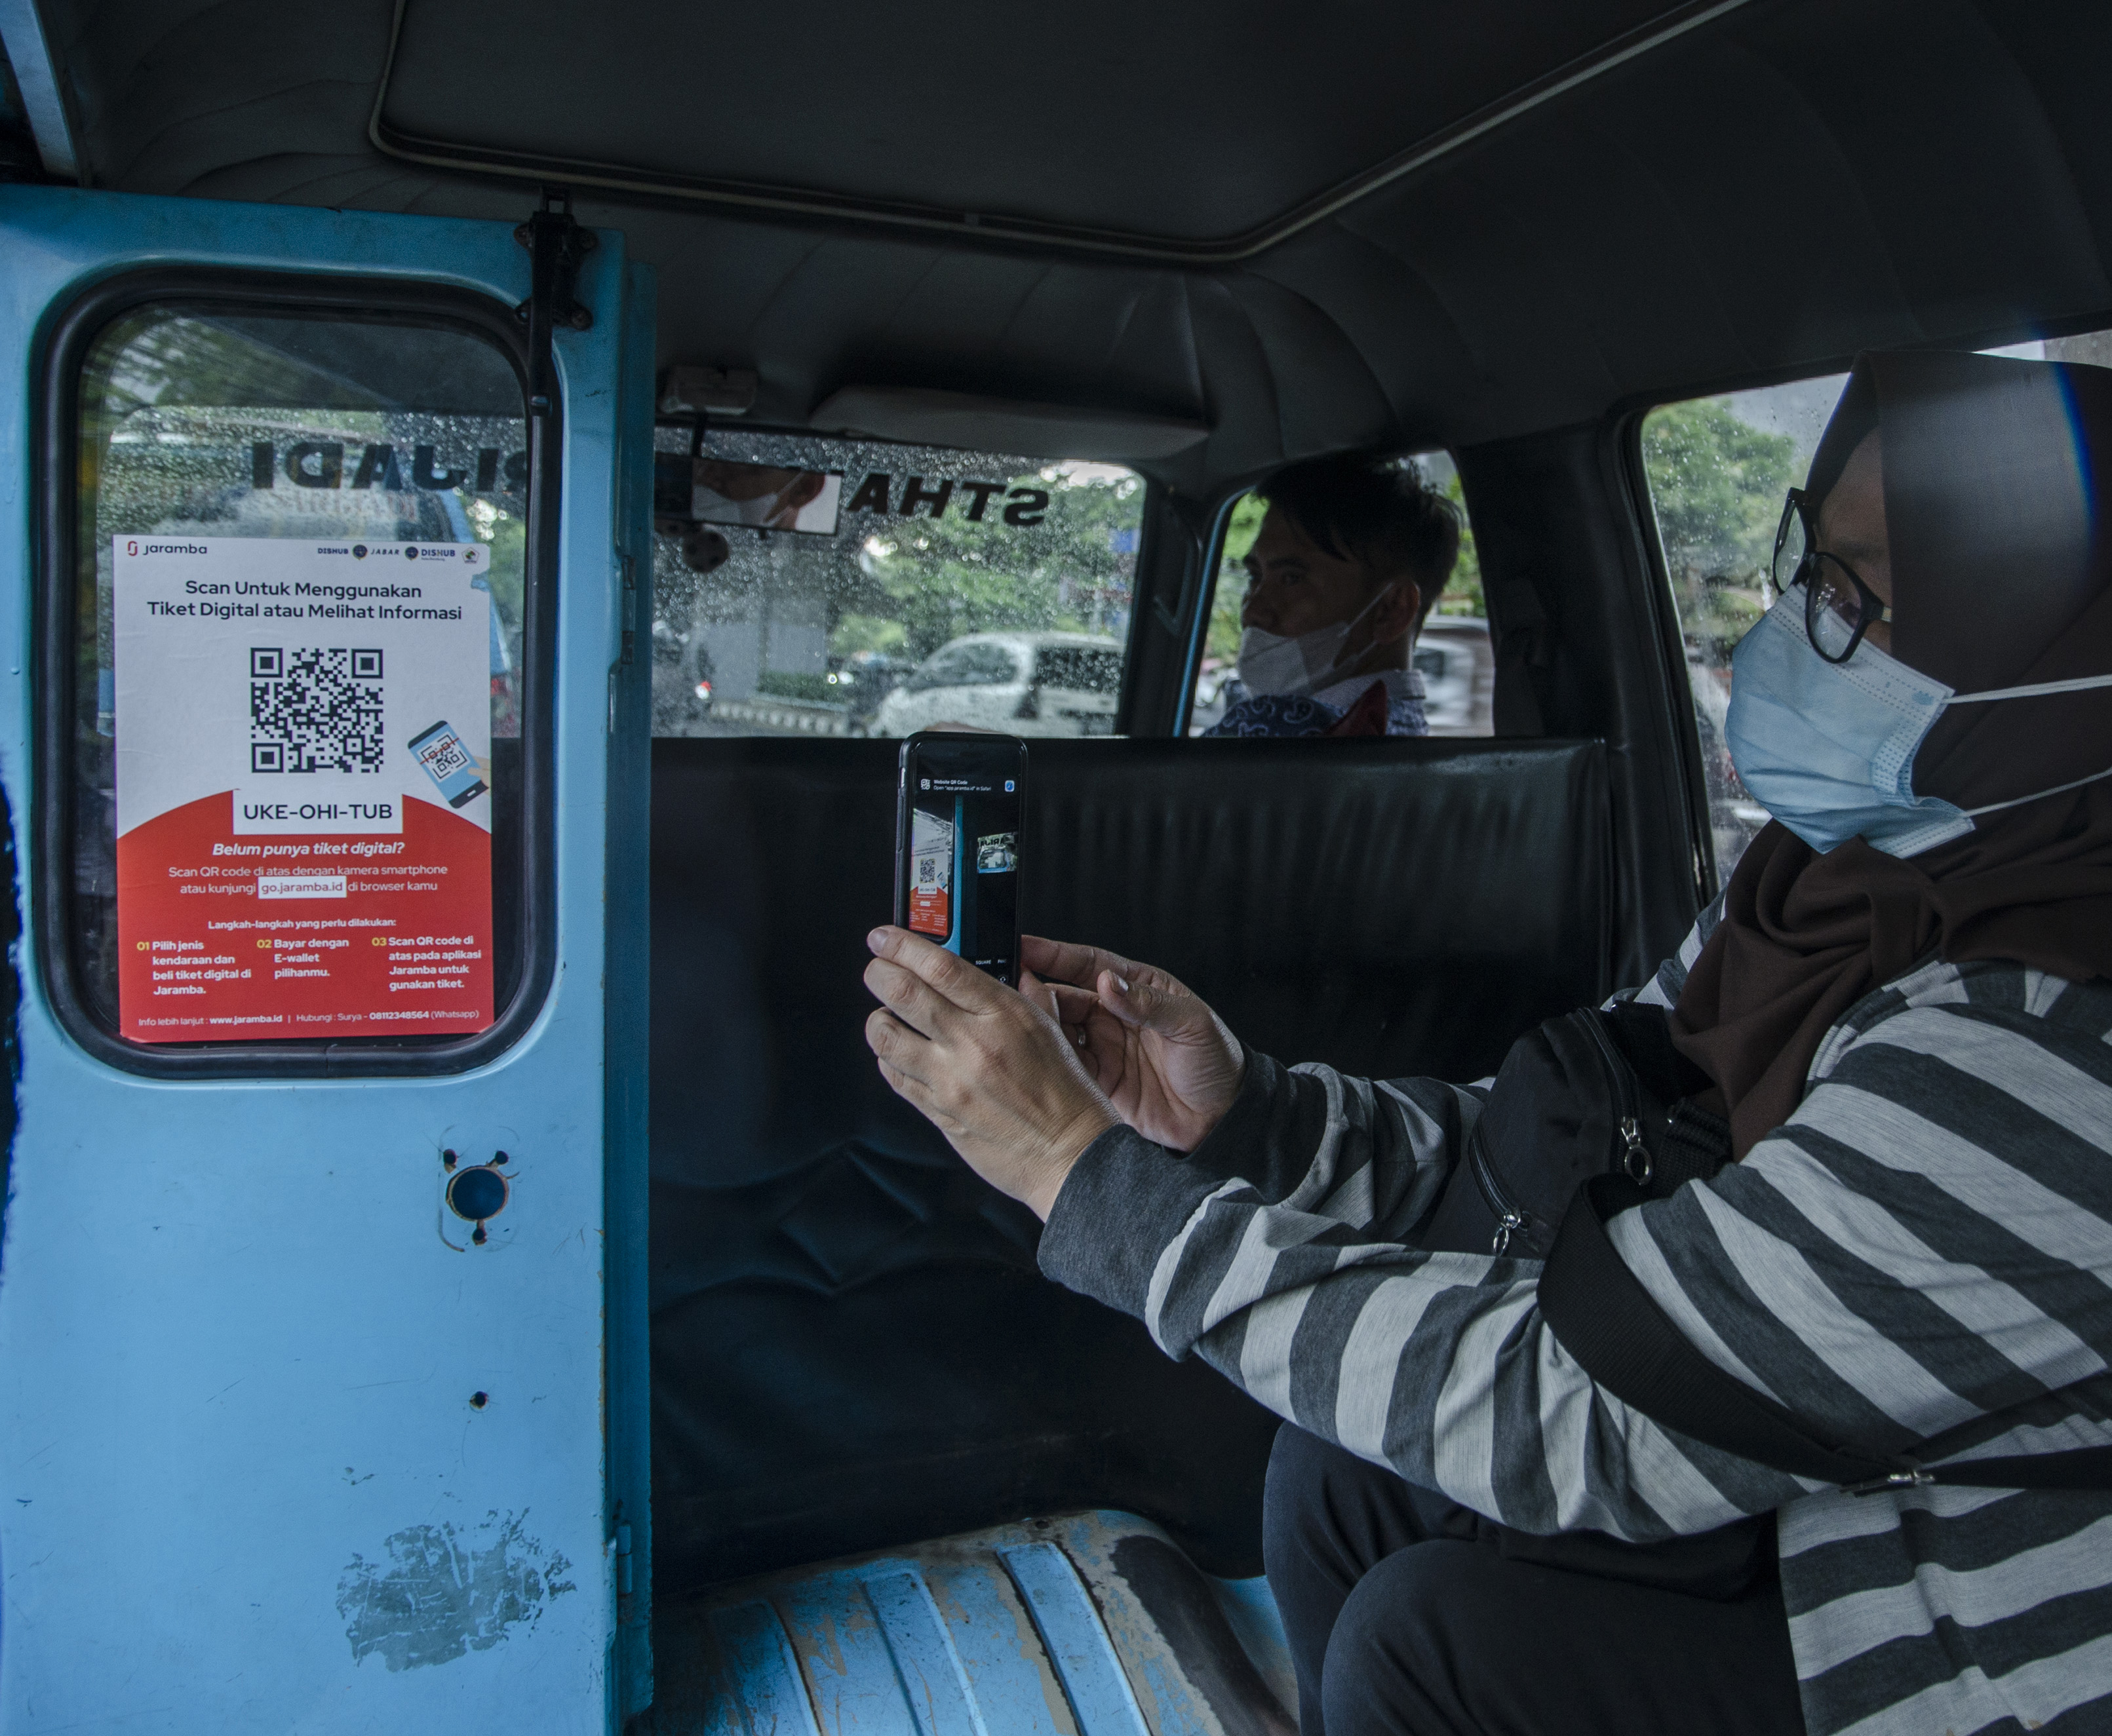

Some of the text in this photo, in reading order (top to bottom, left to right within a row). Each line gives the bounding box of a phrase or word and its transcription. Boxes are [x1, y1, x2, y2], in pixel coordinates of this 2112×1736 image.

[143, 544, 206, 555] jaramba
[186, 581, 421, 600] Scan Untuk Menggunakan
[147, 602, 461, 619] Tiket Digital atau Melihat Informasi
[244, 804, 392, 819] UKE-OHI-TUB
[213, 842, 405, 858] Belum punya tiket digital?
[169, 864, 448, 877] Scan QR code di atas dengan kamera smartphone
[180, 881, 437, 895] atau kunjungi go.jaramba.id di browser kamu
[208, 918, 396, 931] Langkah-langkah yang perlu dilakukan:
[137, 940, 204, 952] 01 Pilih jenis
[257, 938, 349, 950] 02 Bayar dengan
[389, 937, 415, 946] Scan
[416, 936, 433, 945] QR
[435, 936, 461, 945] code
[463, 936, 473, 944] di
[153, 955, 235, 965] kendaraan dan
[275, 954, 319, 963] E-wallet
[414, 951, 440, 962] pada
[442, 950, 481, 961] aplikasi
[153, 969, 251, 981] beli tiket digital di
[275, 968, 330, 979] pilihanmu.
[389, 965, 469, 974] Jaramba untuk
[153, 985, 206, 995] Jaramba.
[389, 979, 464, 992] gunakan tiket.
[210, 1015, 283, 1025] www.jaramba.id
[296, 1014, 332, 1022] Hubungi
[338, 1013, 362, 1022] Surya
[431, 1010, 479, 1020] (Whatsapp)
